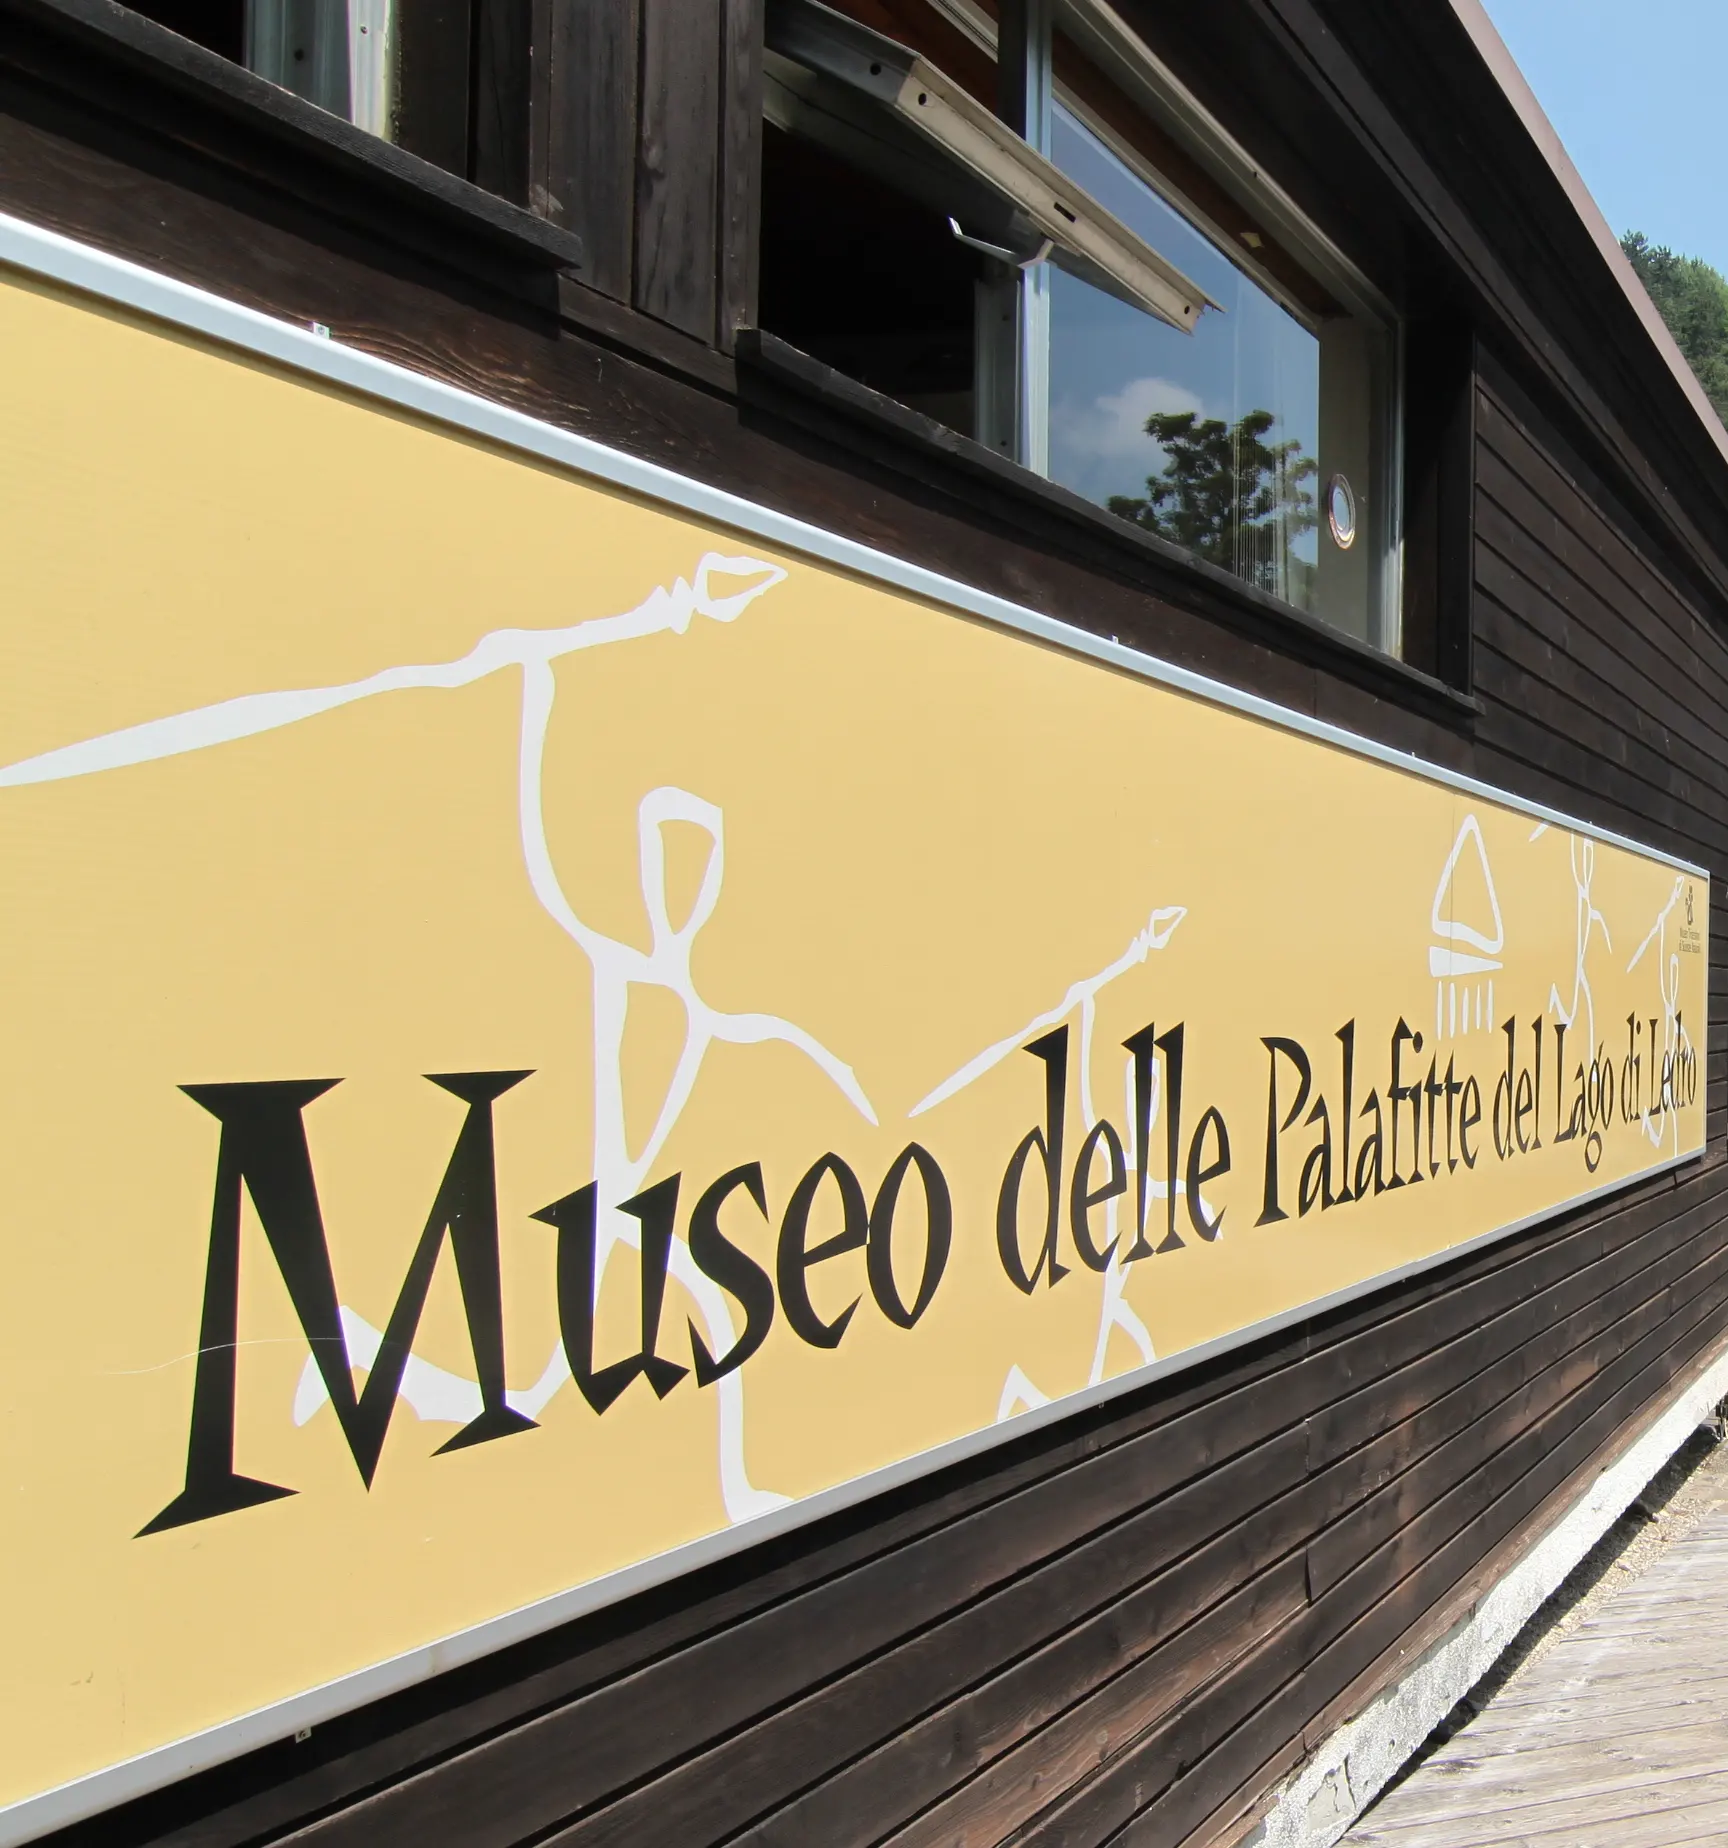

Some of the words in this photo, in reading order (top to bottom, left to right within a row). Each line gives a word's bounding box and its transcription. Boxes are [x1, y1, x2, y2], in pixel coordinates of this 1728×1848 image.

[132, 1069, 952, 1539] Museo
[996, 1020, 1232, 1296] delle
[1254, 1014, 1482, 1228] Palafitte
[1492, 1014, 1542, 1162] del
[1553, 1022, 1614, 1174] Lago
[1621, 1010, 1641, 1125] di
[1648, 1009, 1697, 1117] Ledro
